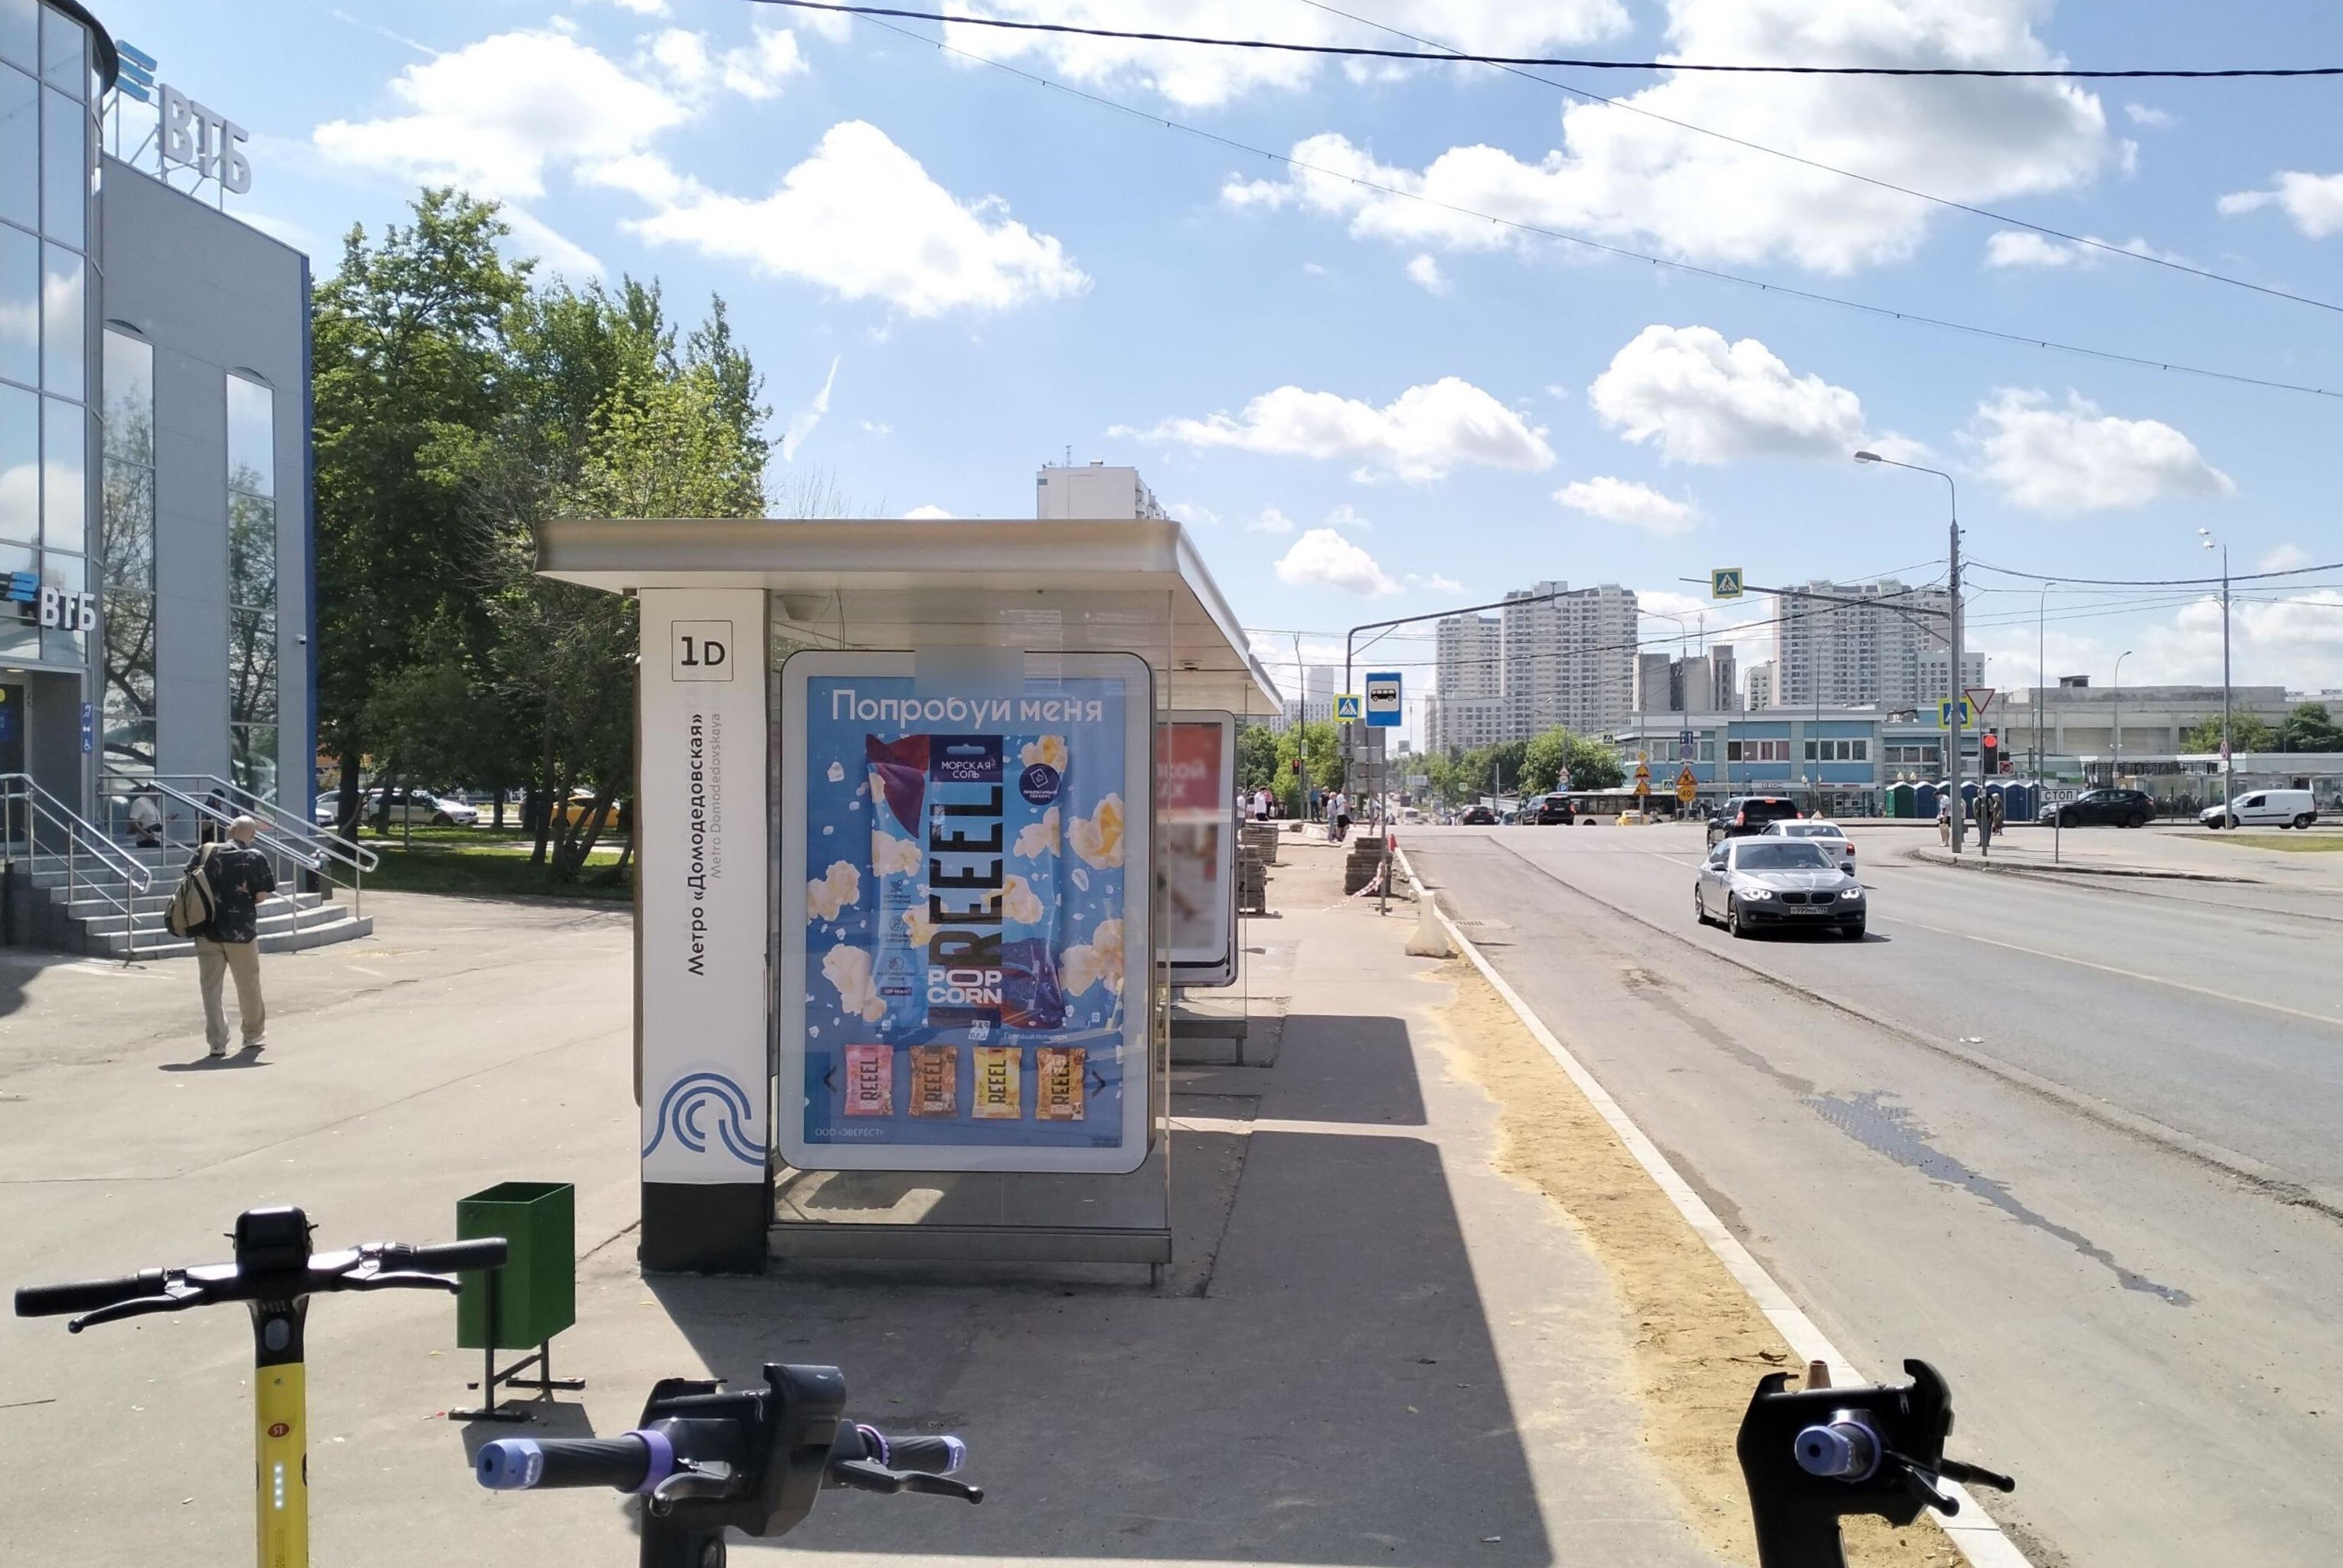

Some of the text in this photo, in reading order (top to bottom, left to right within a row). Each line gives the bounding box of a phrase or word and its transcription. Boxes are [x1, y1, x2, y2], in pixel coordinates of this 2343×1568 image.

[158, 83, 251, 194] ВТБ
[41, 586, 96, 631] ВТБ
[680, 635, 726, 667] 1D
[1020, 700, 1103, 722] меня
[941, 761, 991, 770] МОРСКАЯ
[953, 770, 980, 779] СОЛЬ
[710, 713, 721, 878] Metro Domodedovskaya
[2045, 791, 2073, 800] СТОП
[687, 714, 707, 976] Метро «Домодедовская»
[927, 969, 1002, 987] POP
[926, 988, 1002, 1004] CORN
